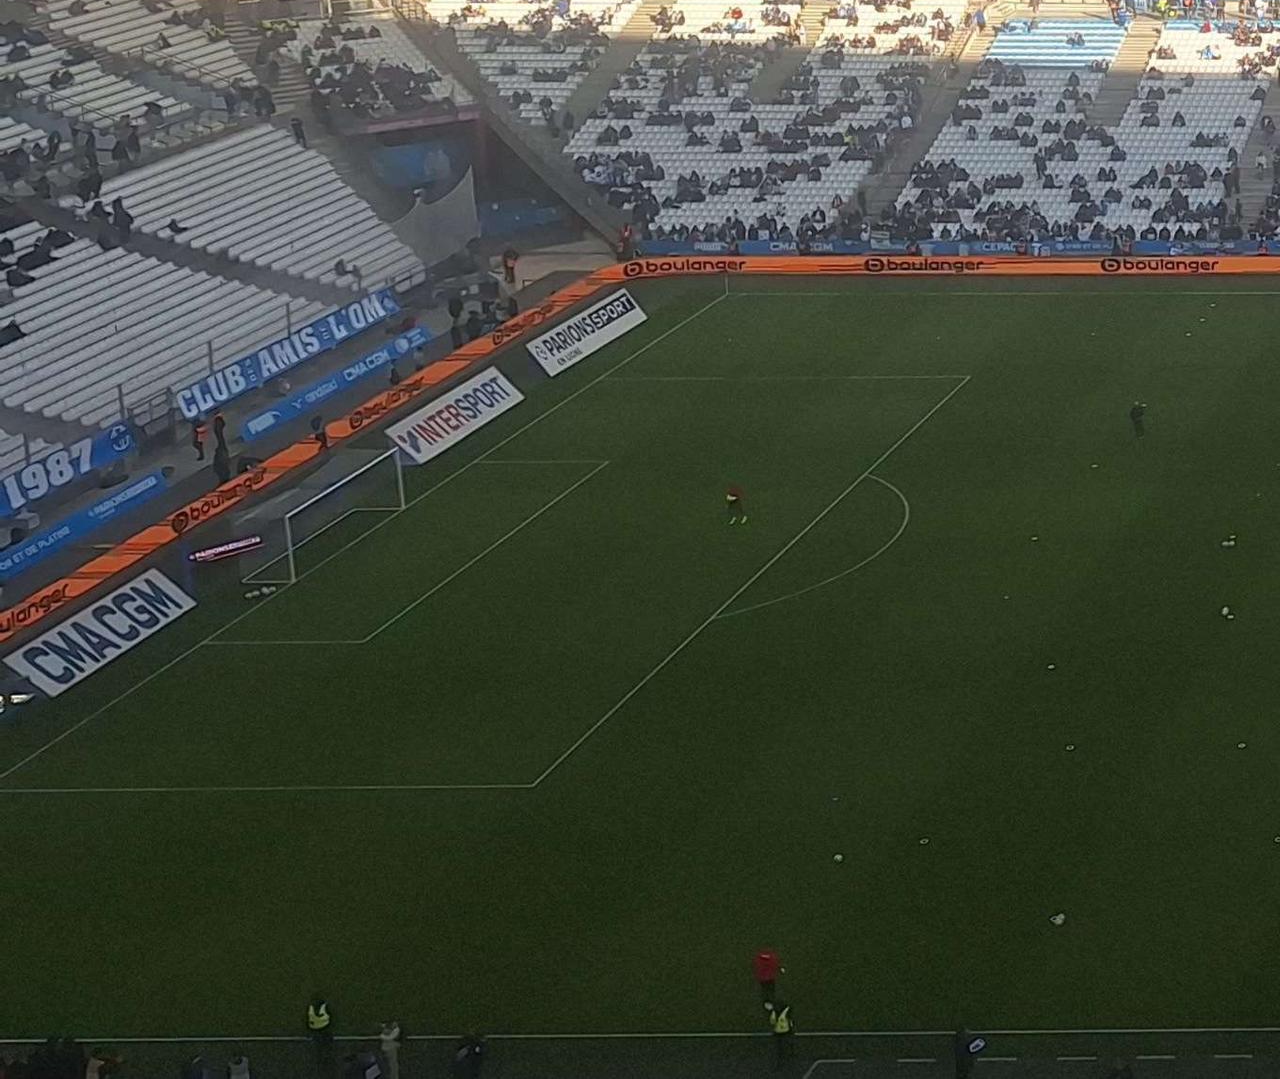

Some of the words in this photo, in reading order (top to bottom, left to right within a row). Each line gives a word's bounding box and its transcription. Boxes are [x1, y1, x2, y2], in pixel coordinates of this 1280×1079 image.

[646, 259, 746, 274] boulanger
[888, 258, 984, 272] boulanger
[1123, 258, 1219, 272] boulanger
[177, 361, 248, 419] CLUB
[256, 327, 320, 378] AMIS
[328, 294, 387, 340] L'OM
[343, 361, 368, 382] CMA
[415, 376, 511, 447] INTERSPORT
[3, 437, 93, 510] 1987
[22, 622, 122, 685] CMA
[90, 578, 184, 643] CGM
